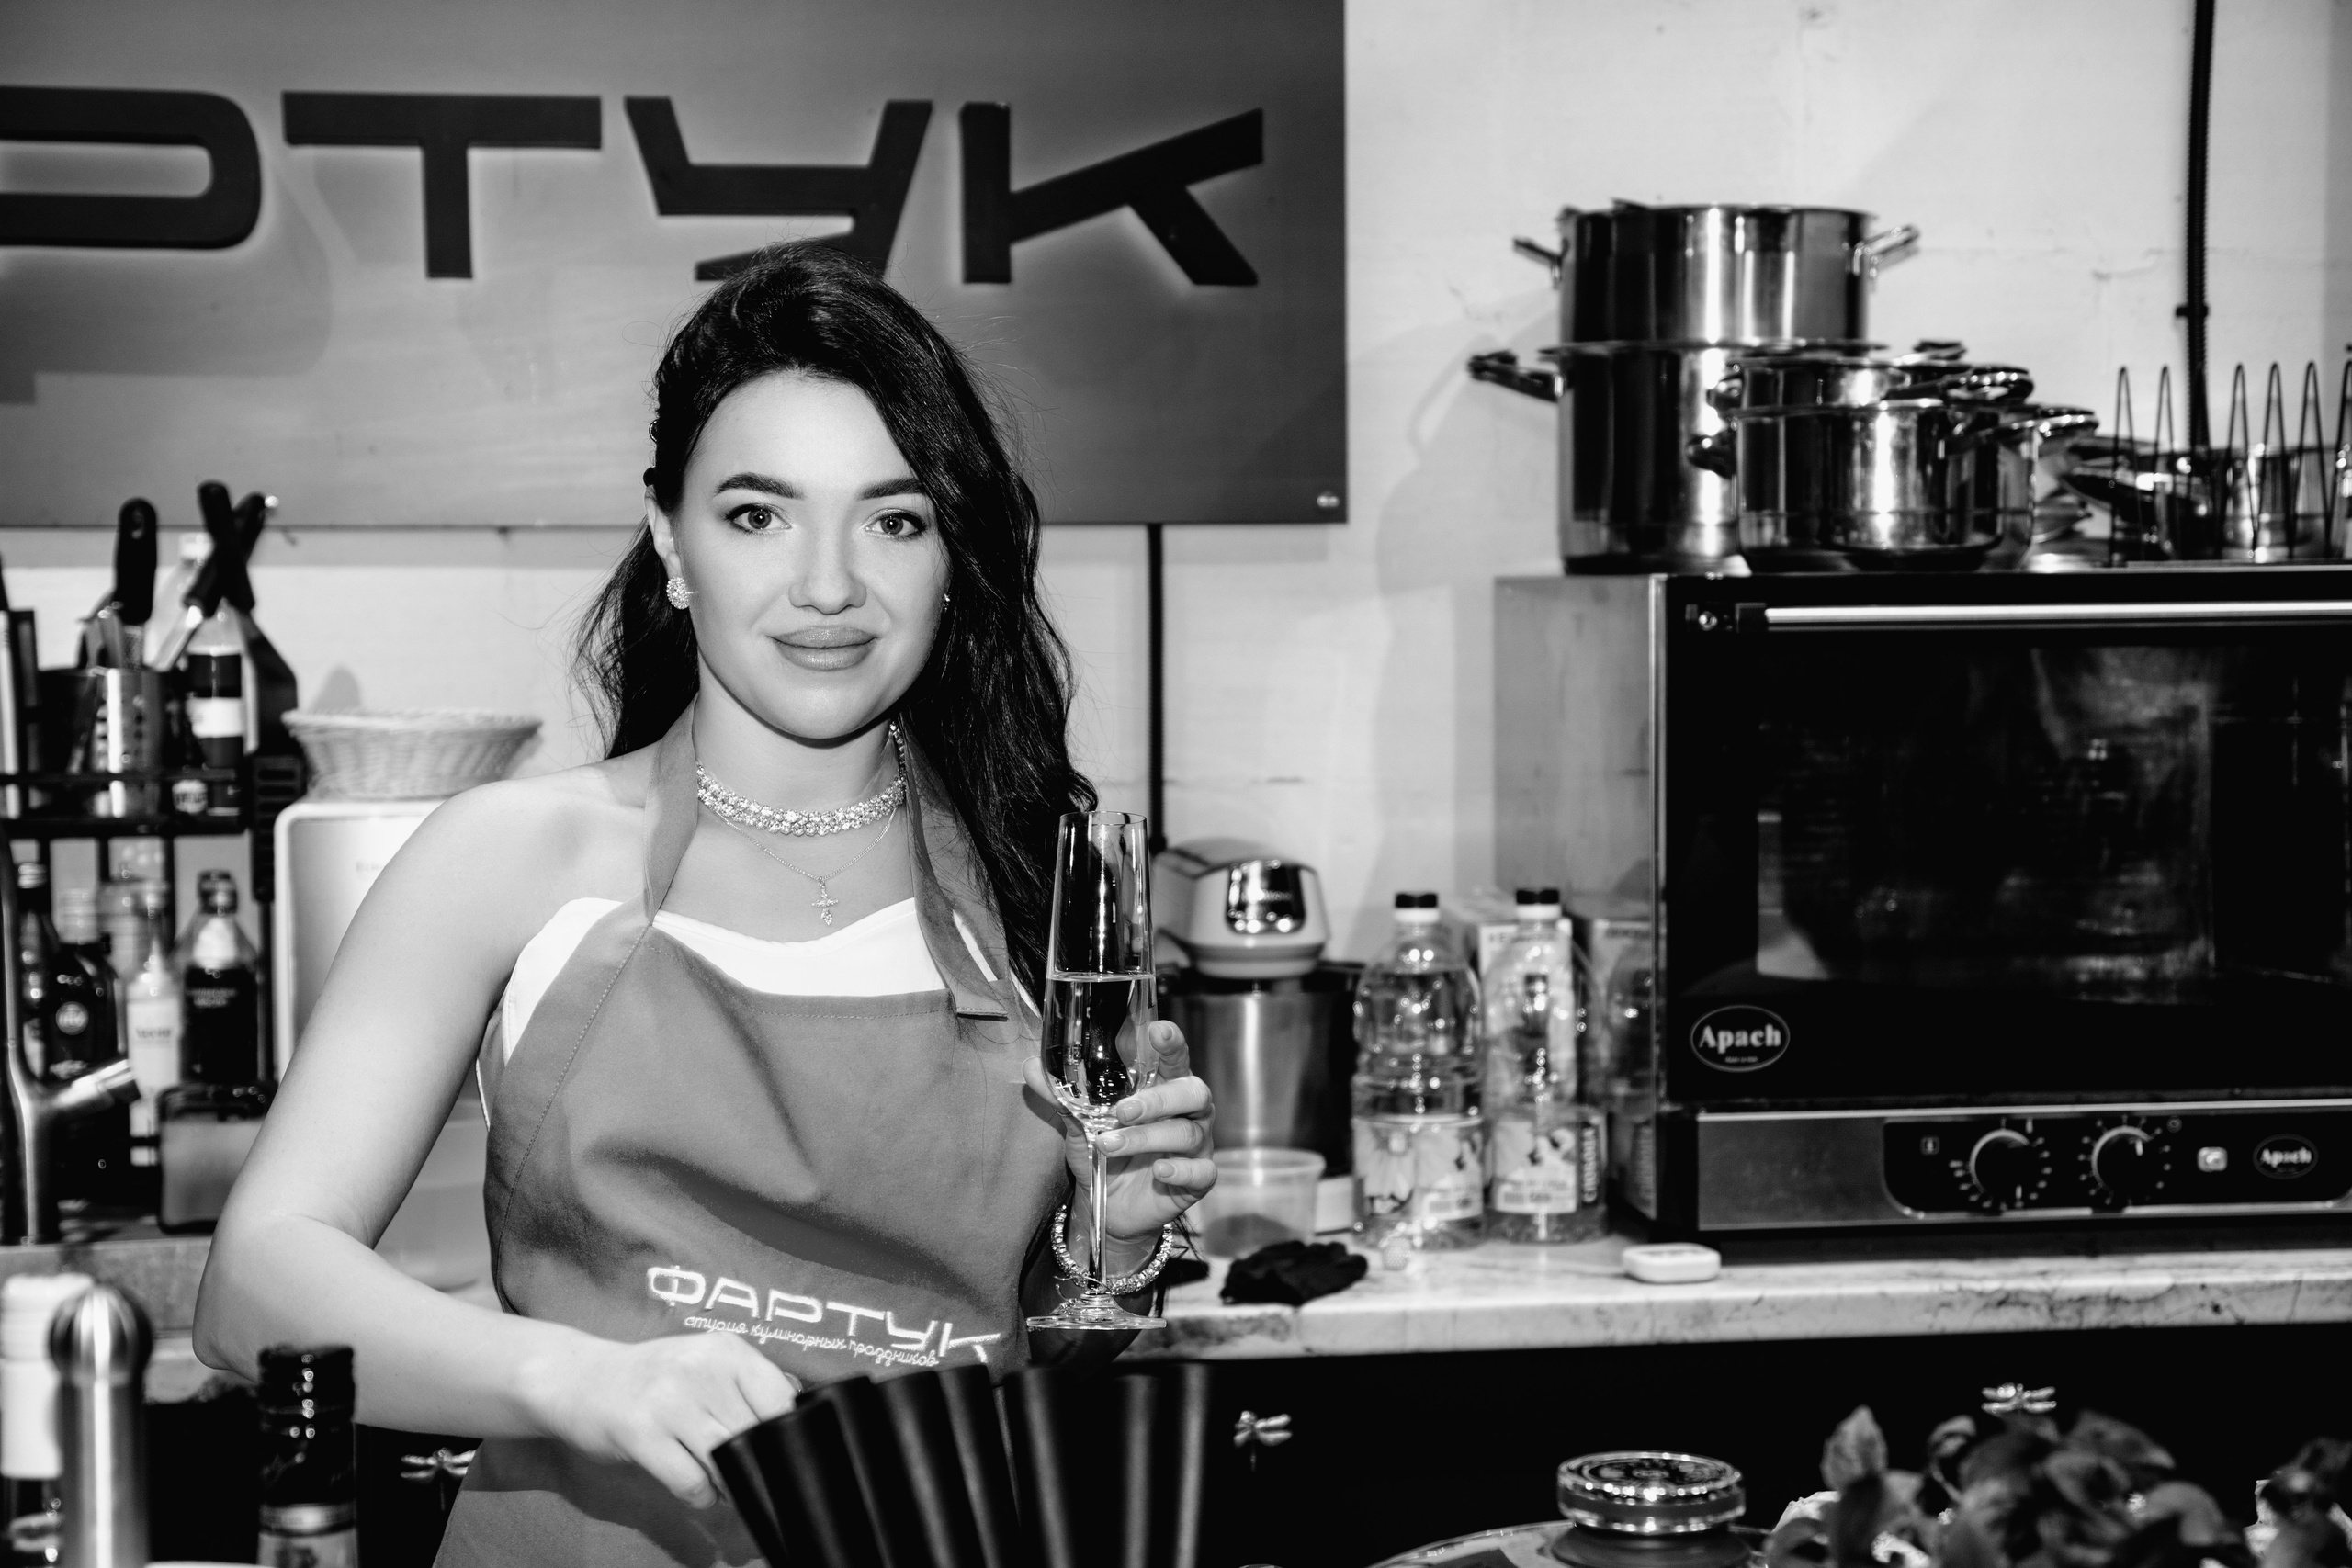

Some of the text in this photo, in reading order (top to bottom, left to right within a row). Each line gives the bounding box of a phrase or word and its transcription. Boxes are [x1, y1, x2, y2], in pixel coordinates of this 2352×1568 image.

[1699, 1023, 1781, 1054] Apach
[2261, 1147, 2312, 1168] Apach
[647, 1265, 1001, 1363] ФАРТУК
[684, 1316, 940, 1367] студия кулинарных праздников
